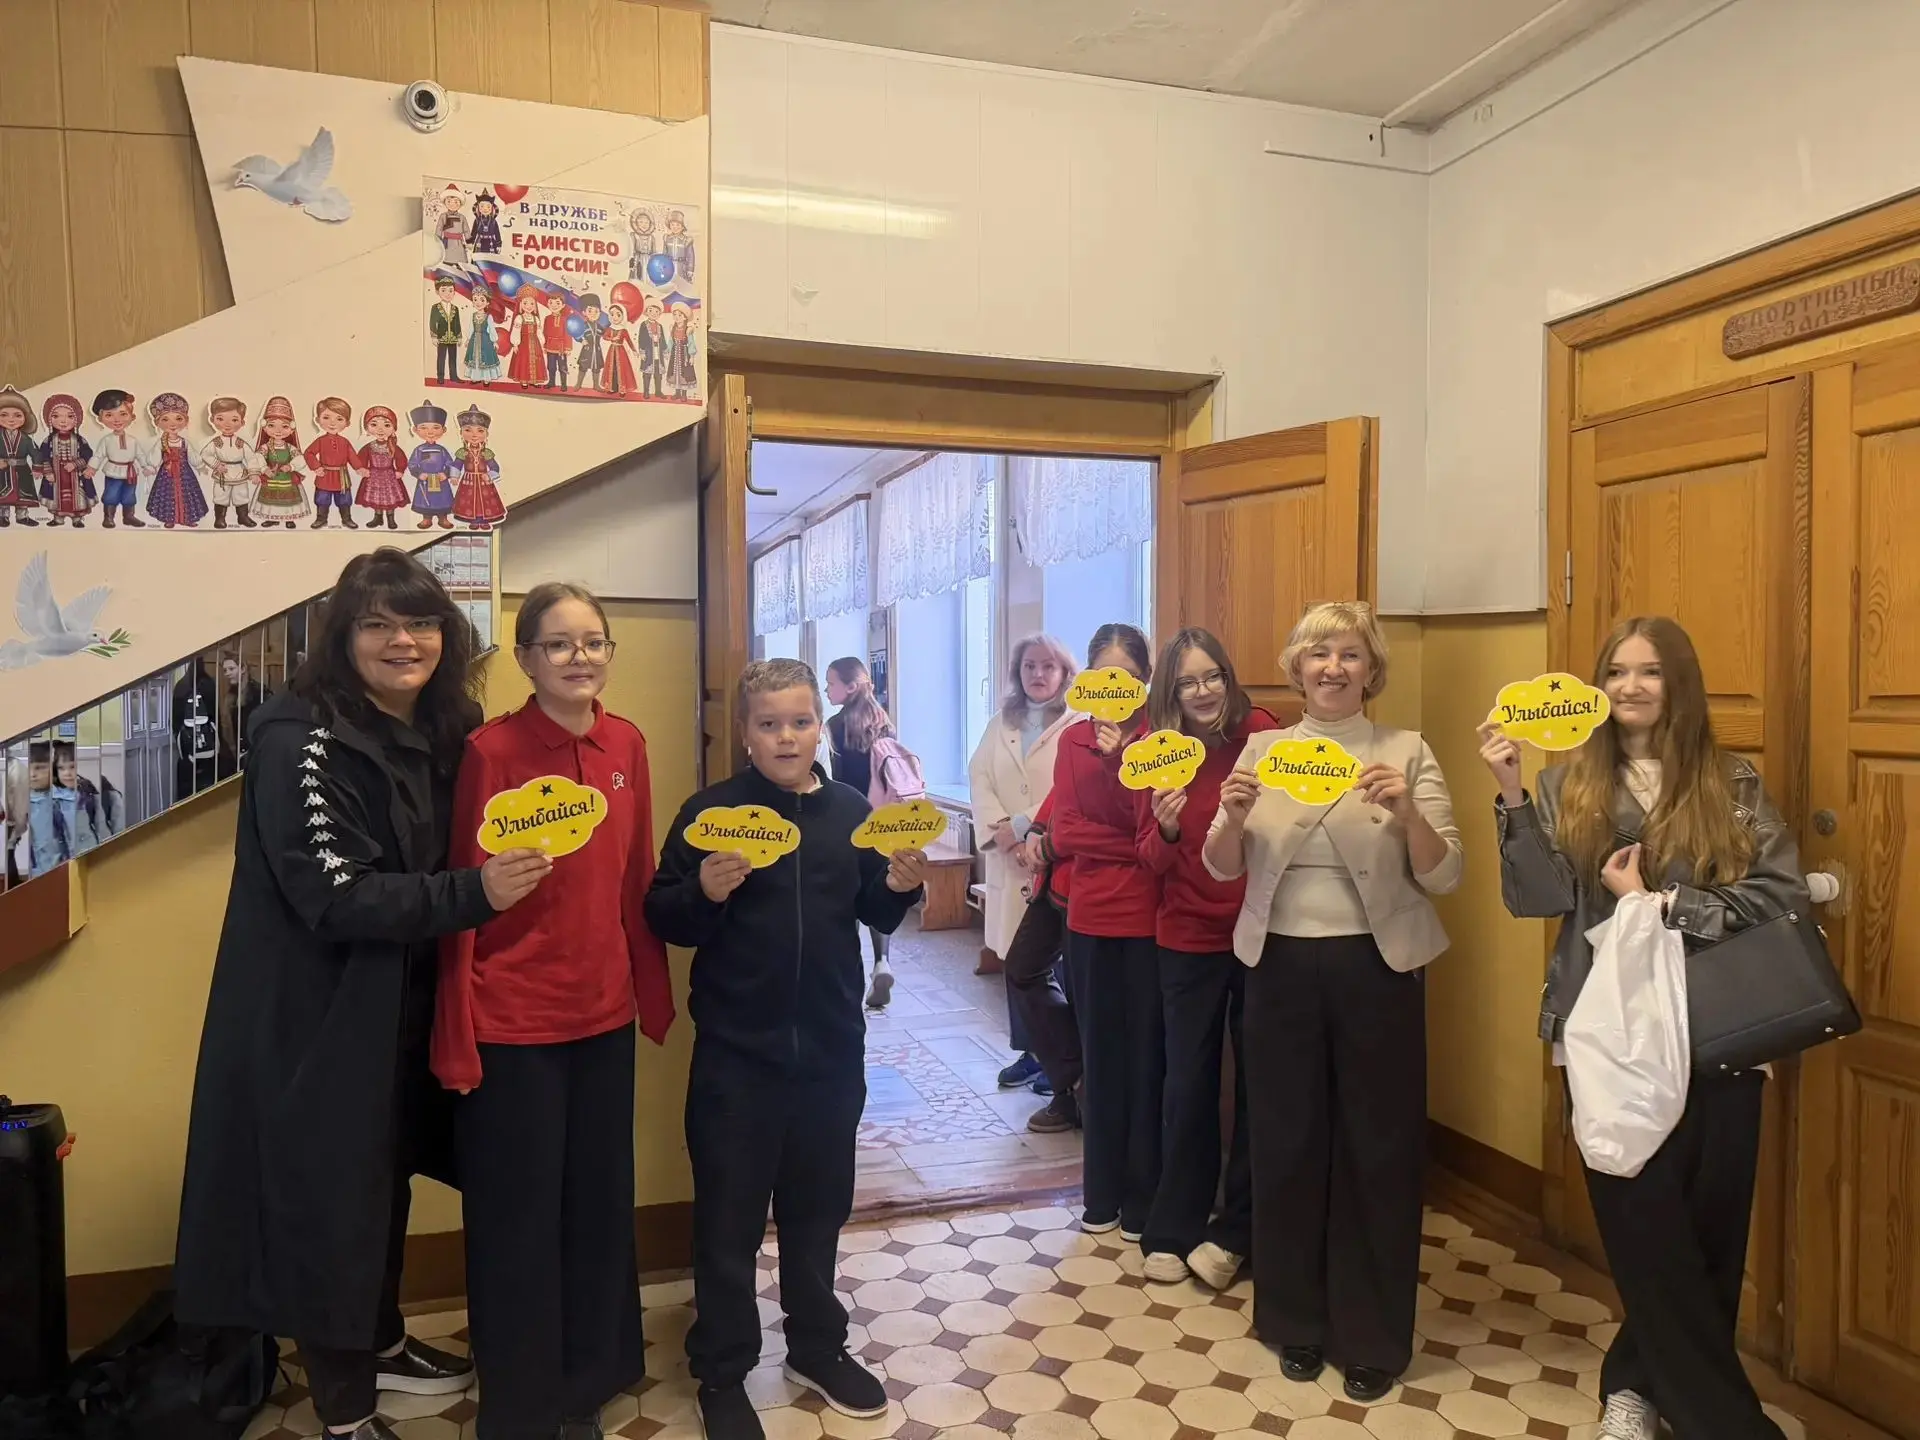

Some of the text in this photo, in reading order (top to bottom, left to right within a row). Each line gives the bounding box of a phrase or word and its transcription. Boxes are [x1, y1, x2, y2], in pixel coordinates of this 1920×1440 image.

[520, 202, 608, 221] В ДРУЖБЕ
[512, 233, 620, 257] ЕДИНСТВО
[523, 254, 609, 276] РОССИИ!
[1733, 266, 1906, 332] СПОРТИВНЫЙ
[1783, 310, 1829, 337] ЗАЛ
[1075, 685, 1140, 700] Улыбайся!
[1501, 694, 1599, 724] Улыбайся!
[1127, 742, 1197, 777] Улыбайся!
[1268, 756, 1356, 779] Улыбайся!
[491, 793, 595, 838] Улыбайся!
[864, 816, 942, 836] Улыбайся!
[699, 822, 792, 843] Улыбайся!
